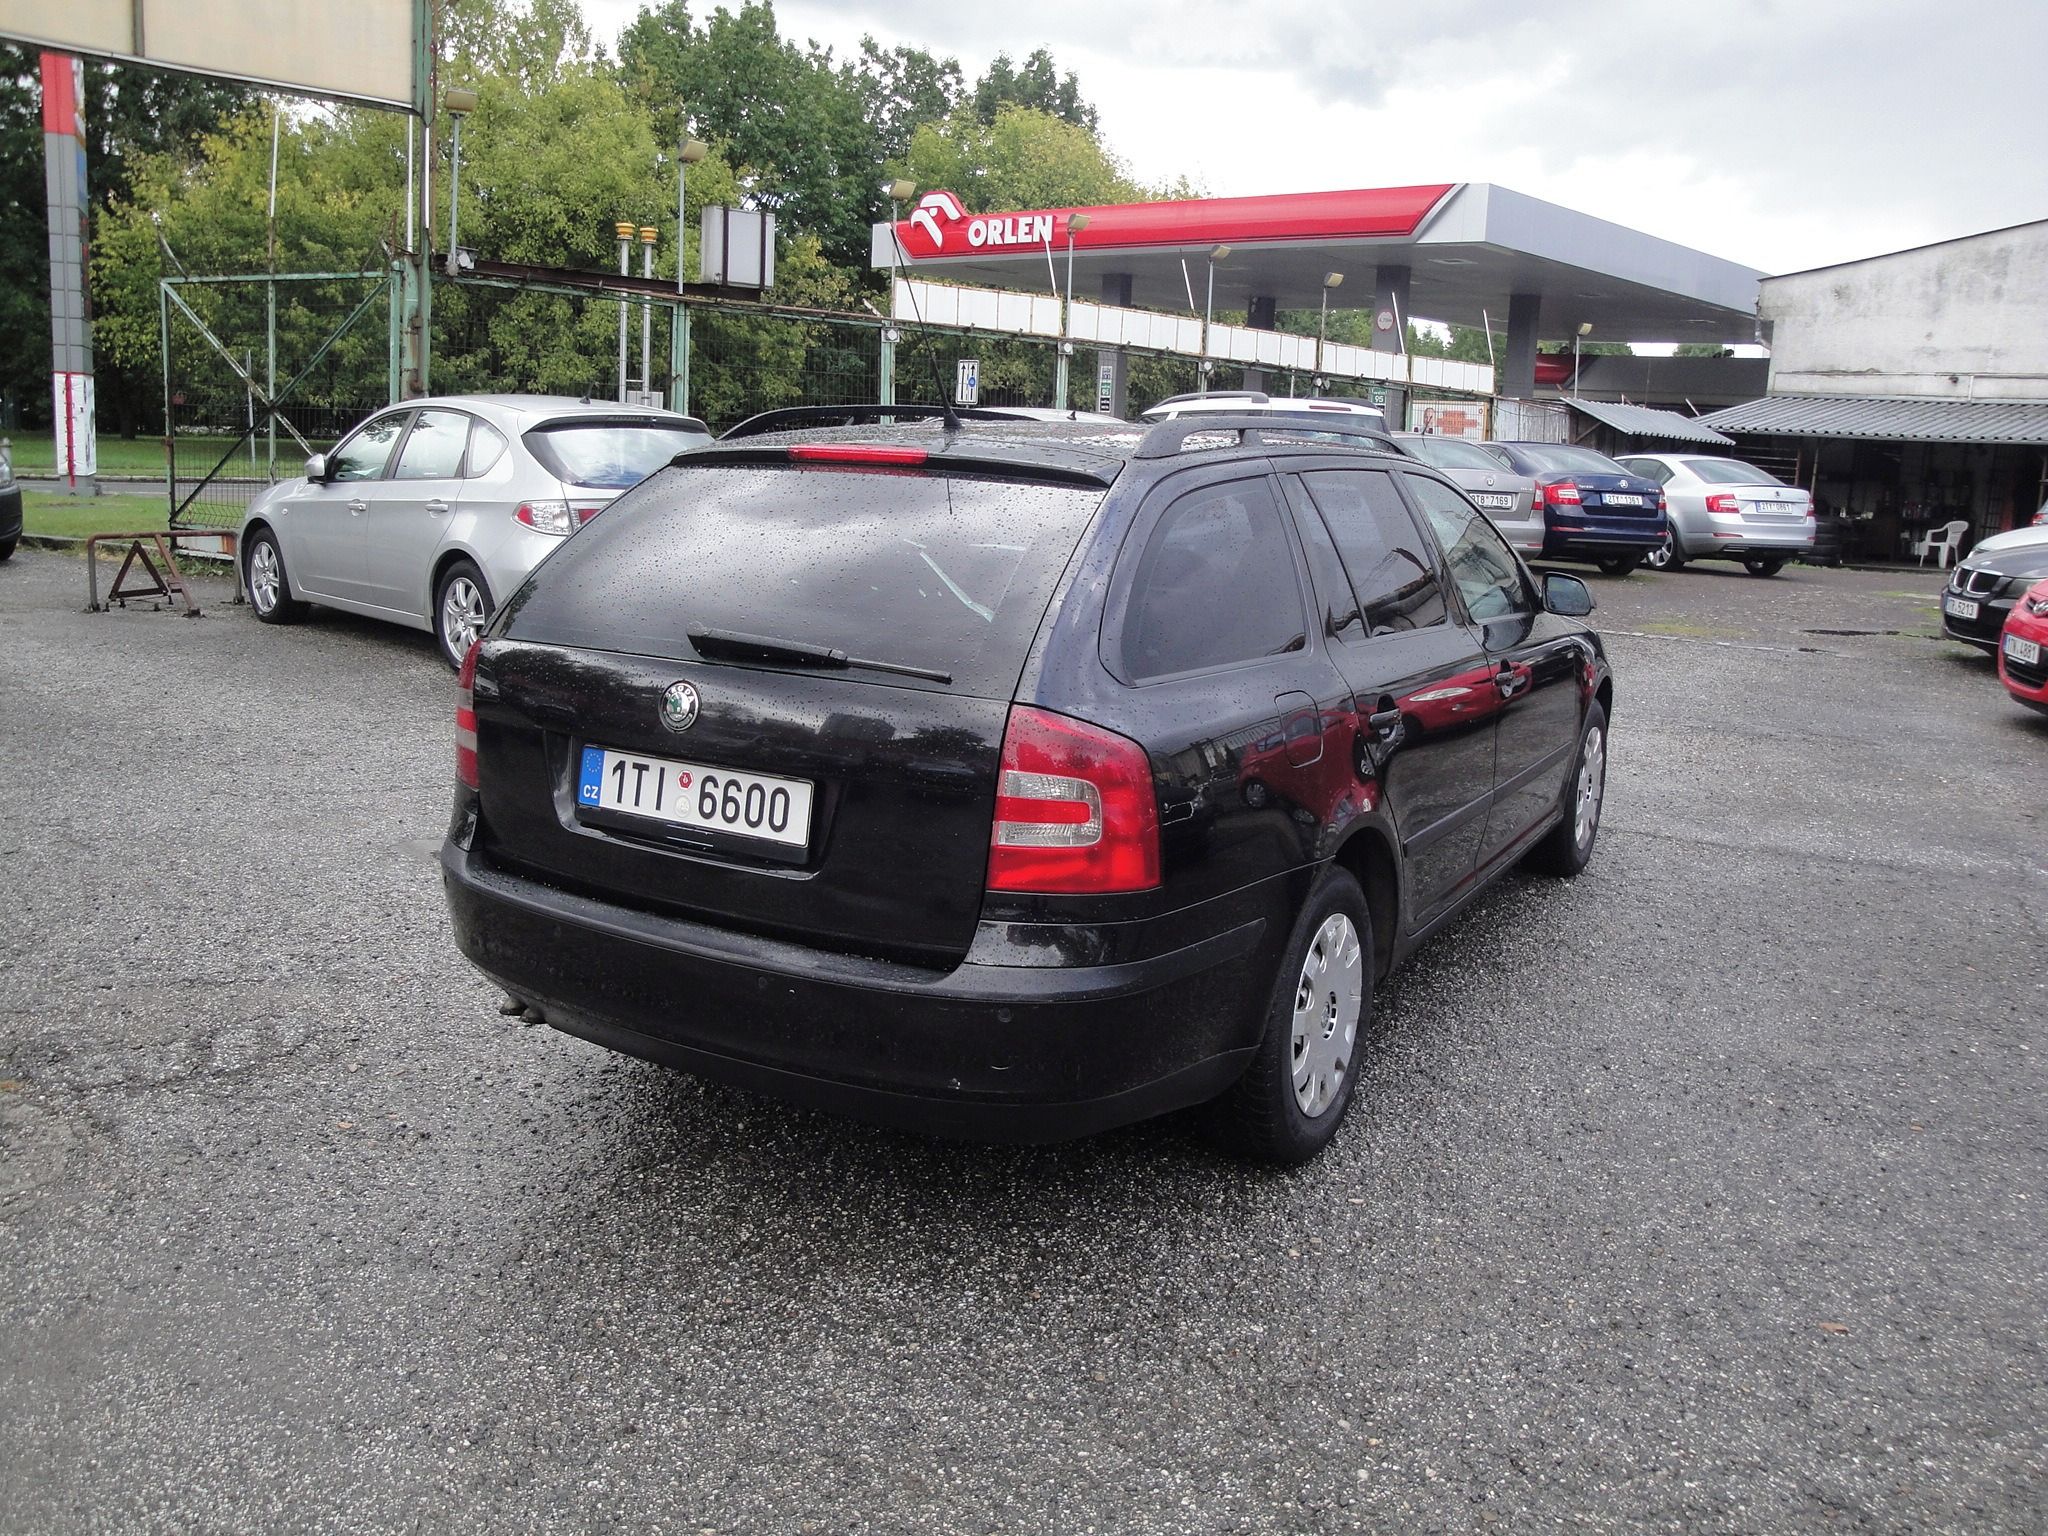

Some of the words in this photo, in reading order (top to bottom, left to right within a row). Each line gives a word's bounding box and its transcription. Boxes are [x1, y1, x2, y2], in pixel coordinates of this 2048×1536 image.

[968, 215, 1053, 247] ORLEN
[1374, 395, 1384, 403] 95
[1490, 496, 1509, 505] 7169
[1957, 601, 1975, 616] 5213
[583, 784, 598, 799] CZ
[612, 760, 665, 811] 1TI
[699, 775, 790, 833] 6600
